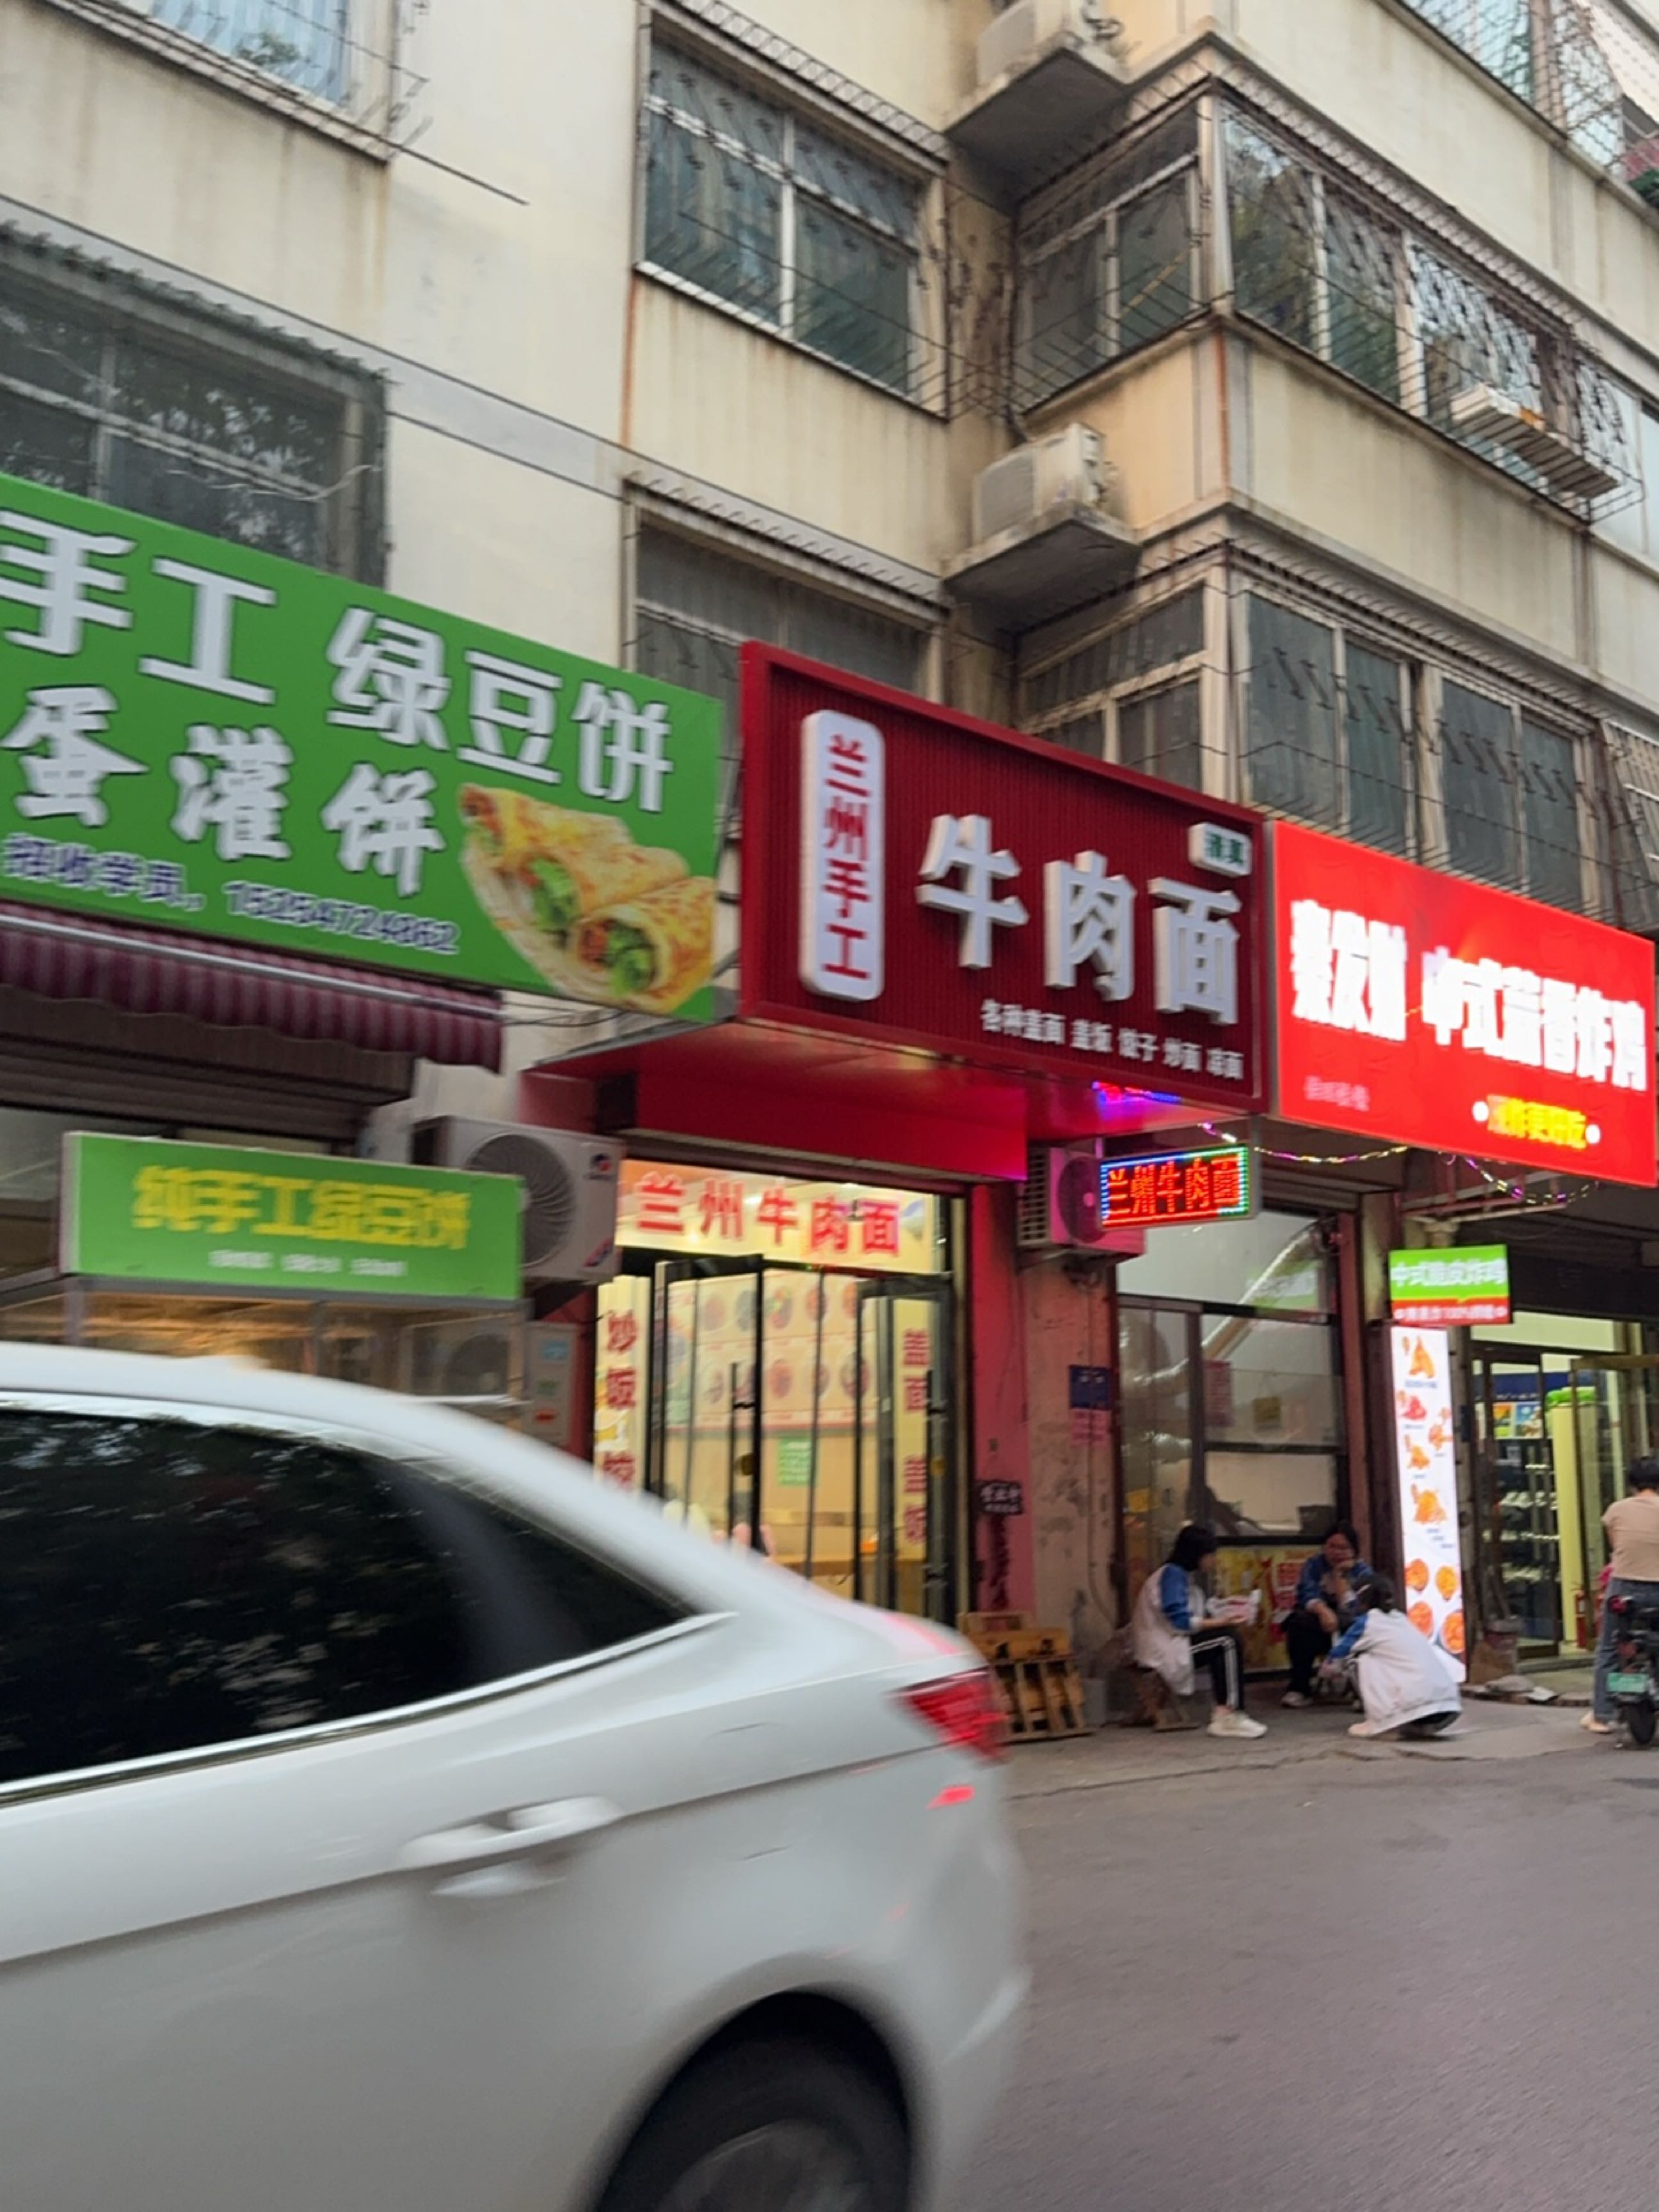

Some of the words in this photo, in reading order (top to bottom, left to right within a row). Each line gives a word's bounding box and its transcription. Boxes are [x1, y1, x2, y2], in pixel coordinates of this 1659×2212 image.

[823, 733, 871, 981] 兰州手工
[915, 813, 1240, 1025] 牛肉面
[132, 1165, 470, 1249] 纯手工绿豆饼
[636, 1171, 900, 1256] 兰州牛肉面
[1107, 1155, 1240, 1215] 兰州牛肉面
